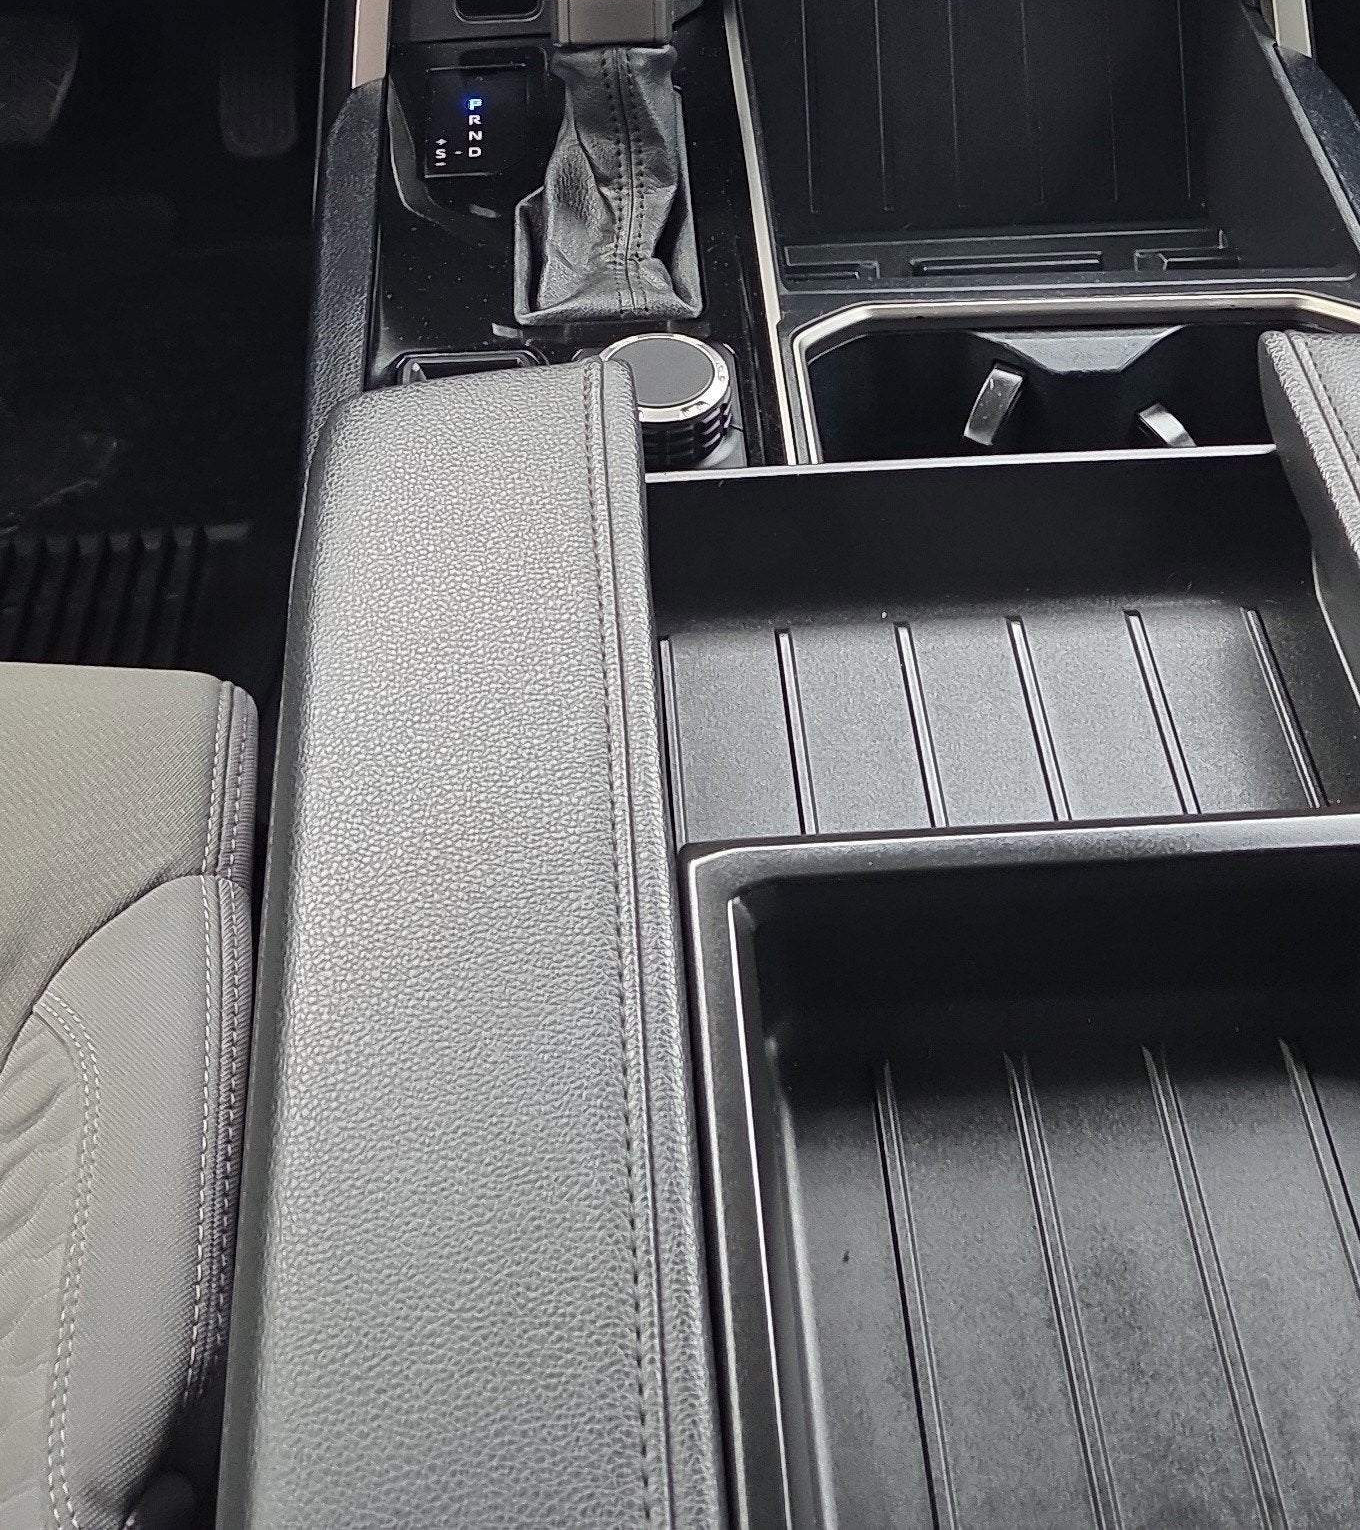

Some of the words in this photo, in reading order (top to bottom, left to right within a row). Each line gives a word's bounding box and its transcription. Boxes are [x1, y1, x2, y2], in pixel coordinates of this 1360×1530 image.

[468, 98, 482, 110] P
[468, 115, 482, 126] R
[468, 130, 482, 141] N
[435, 148, 447, 160] S
[468, 146, 482, 158] D
